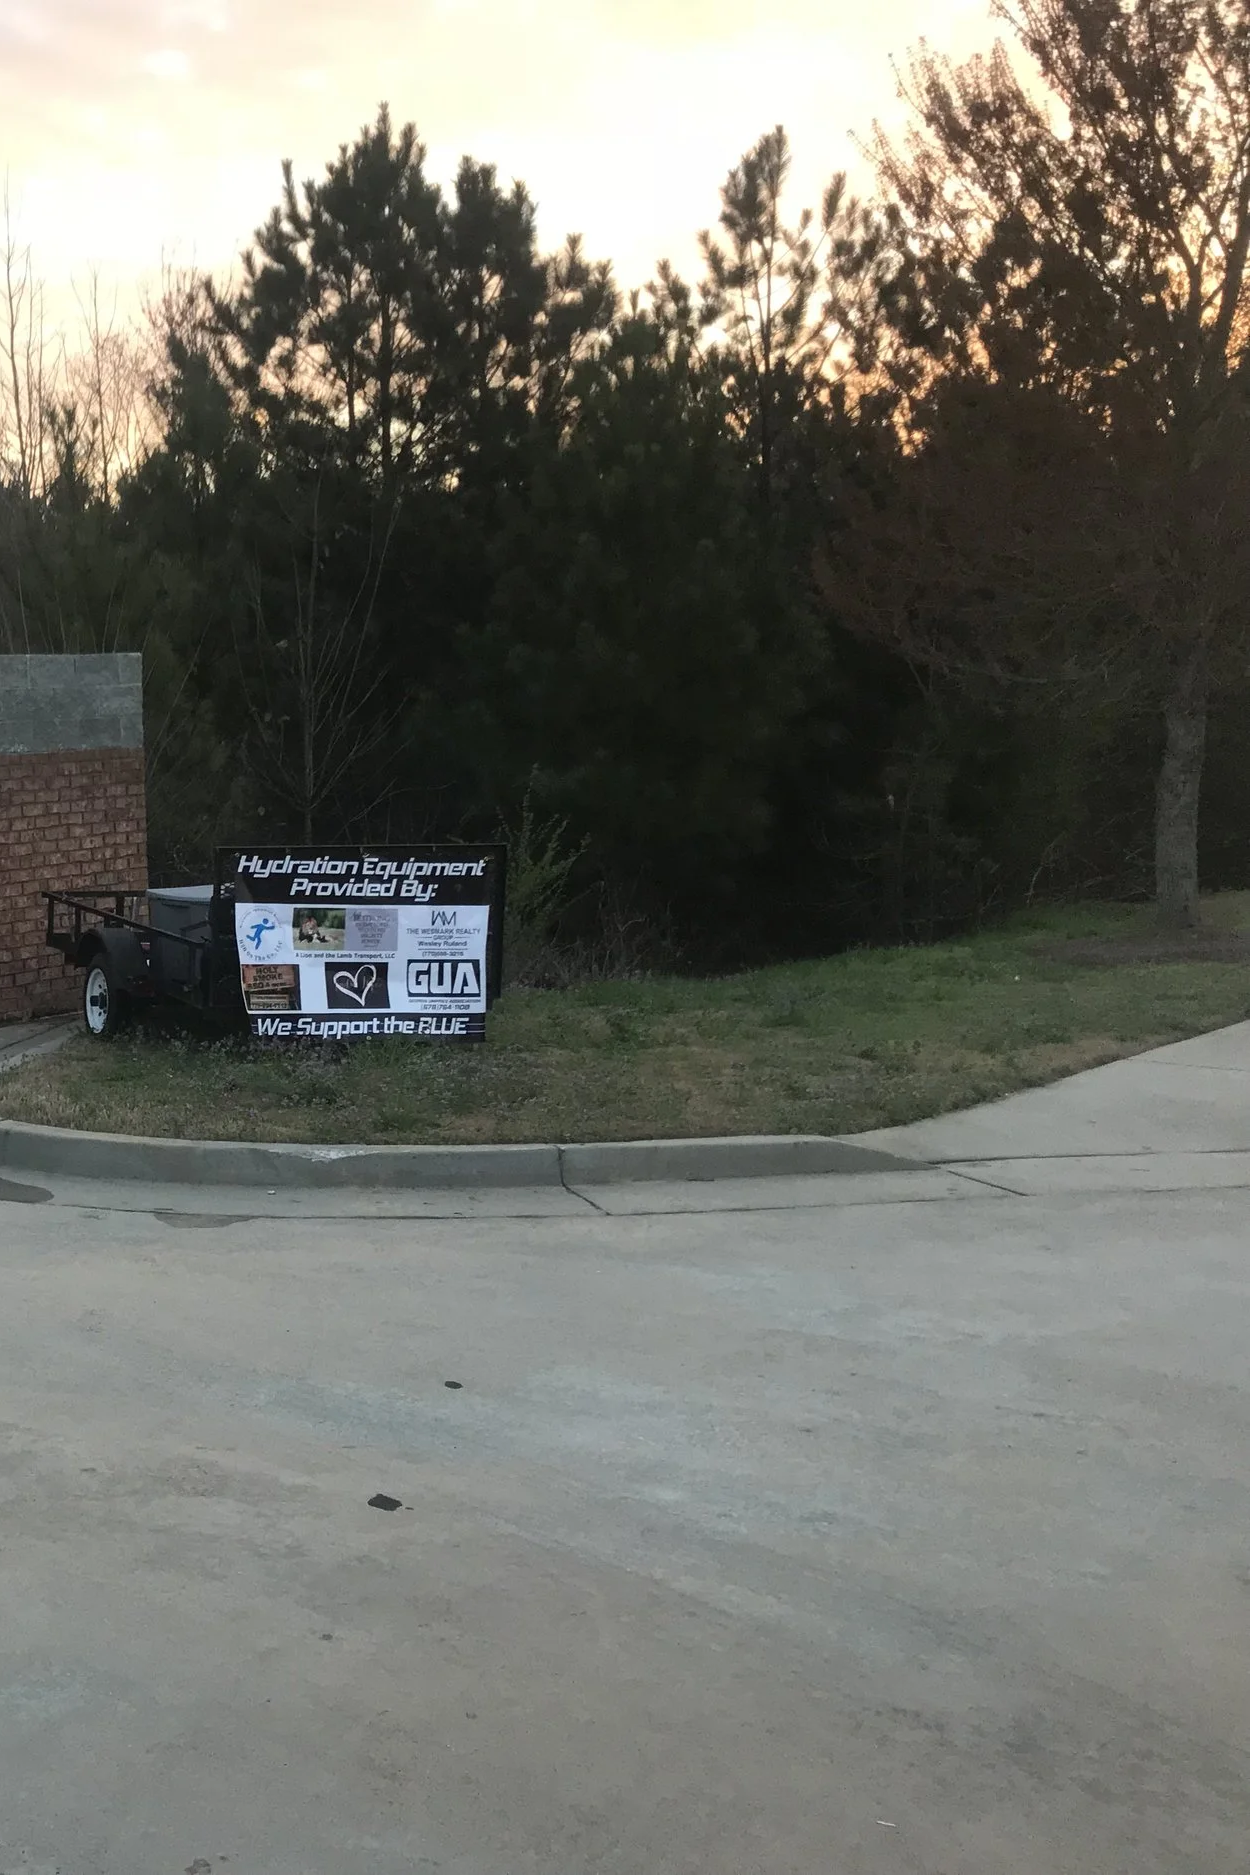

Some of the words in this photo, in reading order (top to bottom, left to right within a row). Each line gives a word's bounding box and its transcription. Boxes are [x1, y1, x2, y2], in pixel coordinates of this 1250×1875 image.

[237, 855, 359, 878] Hydration
[362, 857, 486, 880] Equipment
[289, 878, 399, 897] Provided
[400, 879, 439, 902] By:
[408, 962, 480, 994] GUA
[257, 1018, 292, 1036] We
[296, 1018, 381, 1039] Support
[383, 1016, 417, 1034] the
[418, 1017, 470, 1035] BLUE
